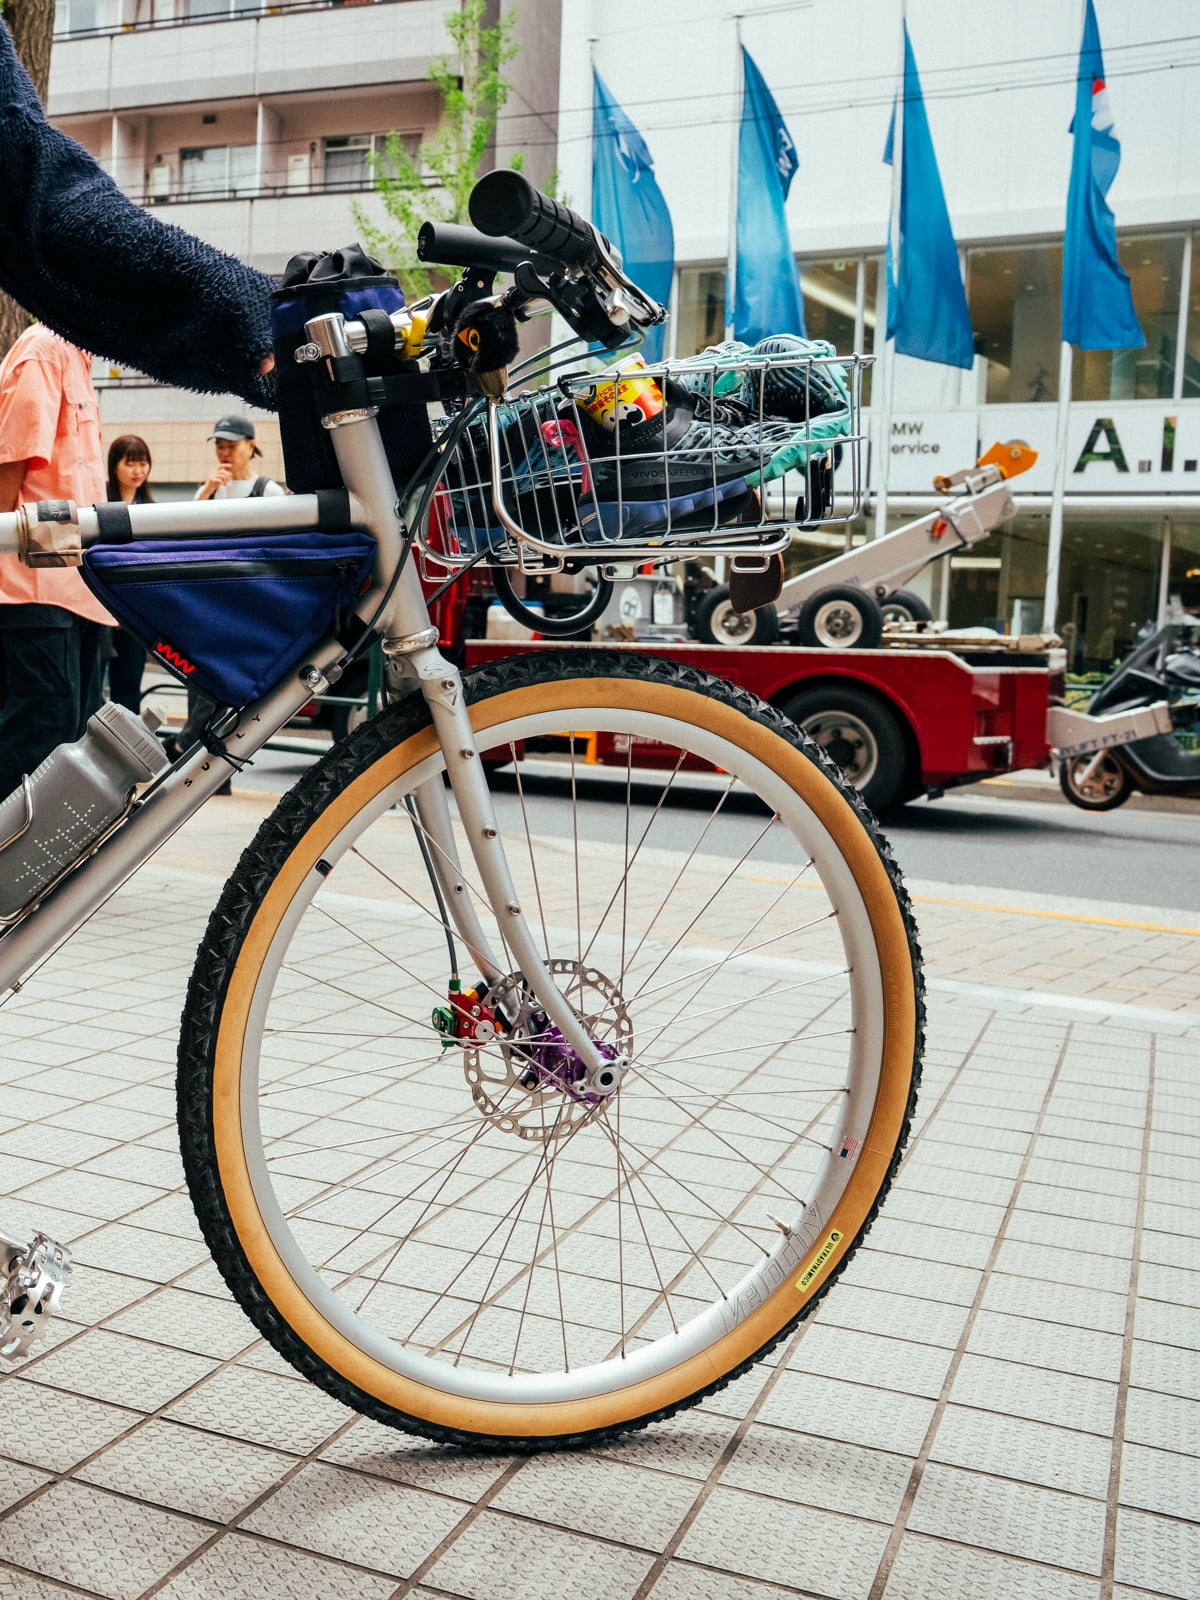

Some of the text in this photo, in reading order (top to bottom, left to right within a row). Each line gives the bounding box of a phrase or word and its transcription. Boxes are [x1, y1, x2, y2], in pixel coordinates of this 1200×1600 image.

[891, 422, 924, 435] MW
[891, 440, 940, 455] ervice
[184, 713, 260, 787] SULY
[801, 1242, 835, 1287] ULTRADYNAMICO
